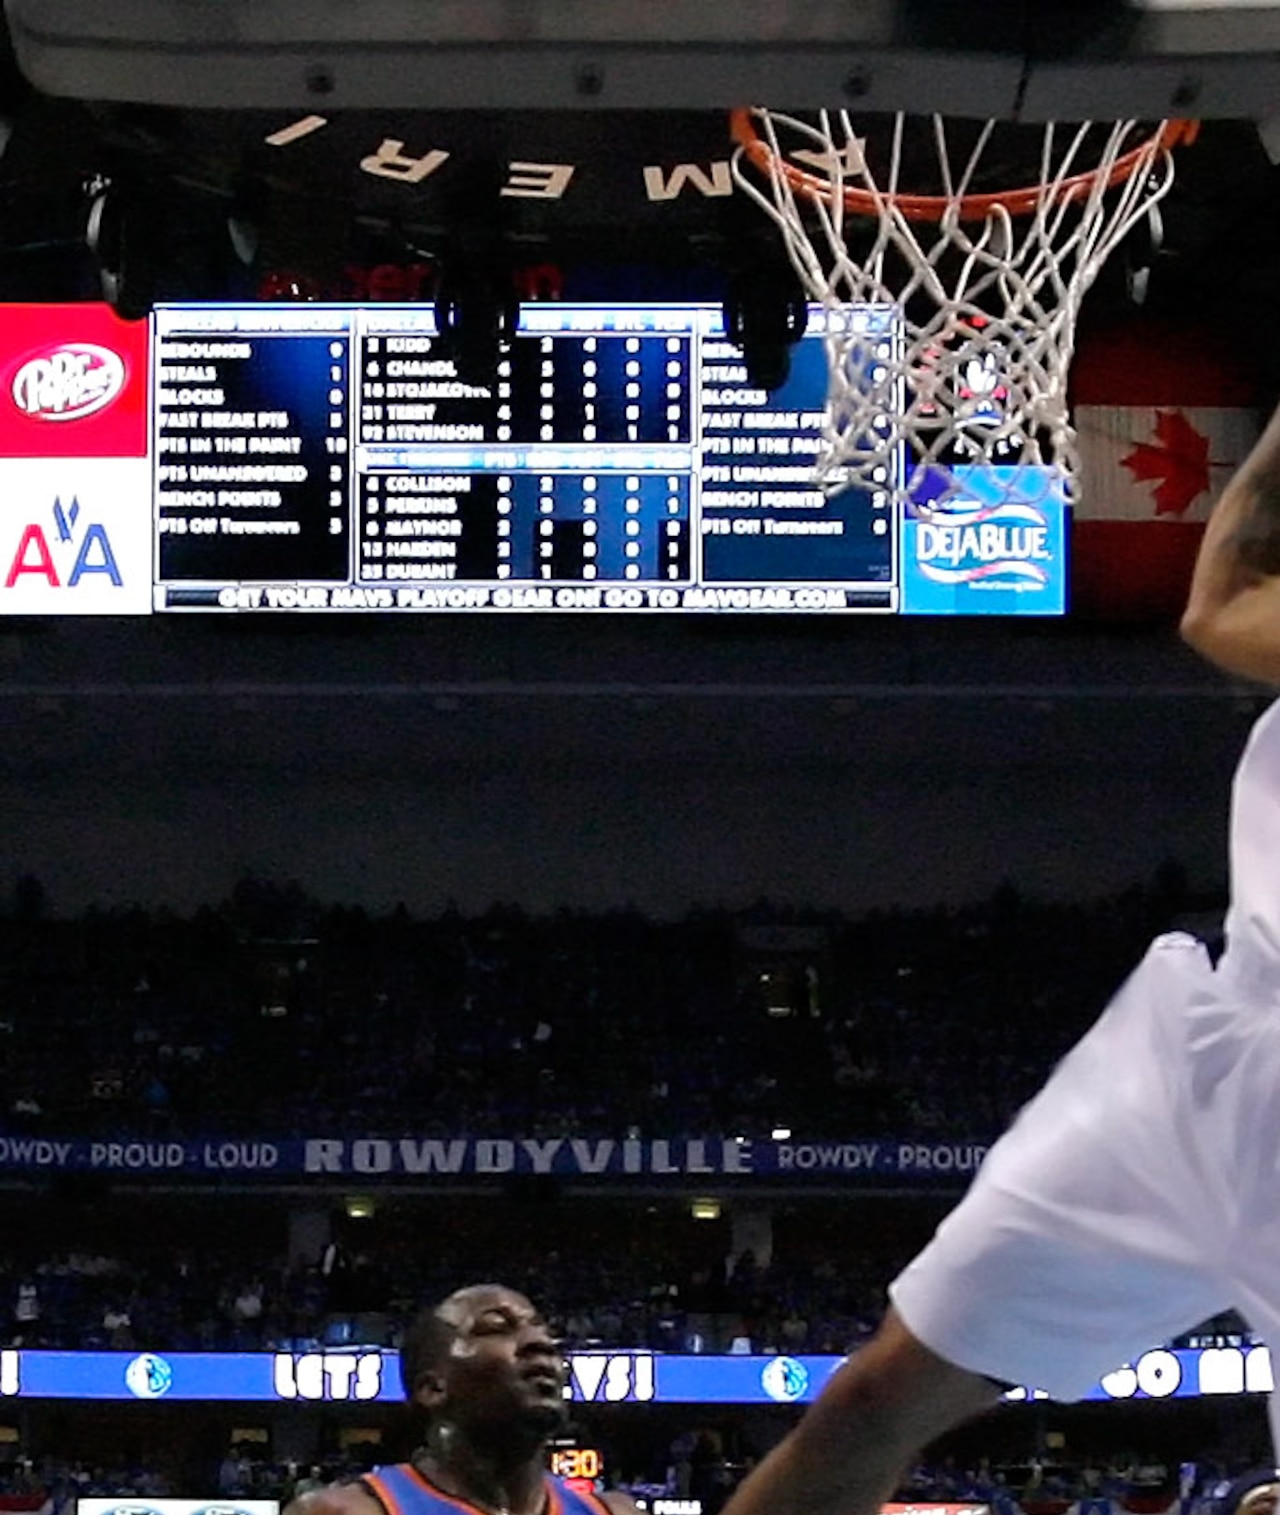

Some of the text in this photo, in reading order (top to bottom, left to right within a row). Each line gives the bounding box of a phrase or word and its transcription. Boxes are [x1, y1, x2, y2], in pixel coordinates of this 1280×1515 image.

[386, 337, 431, 353] KIDD
[386, 360, 457, 377] CHANDL
[385, 476, 471, 492] COLLISON
[263, 587, 329, 608] YOUR
[331, 587, 394, 608] MAVS
[398, 587, 494, 608] PLAYOFF
[604, 588, 644, 609] GO
[648, 588, 680, 609] TO
[91, 1142, 184, 1168] PROUD
[204, 1142, 279, 1169] LOUD
[304, 1138, 754, 1173] ROWDYVILLE
[778, 1145, 879, 1169] ROWDY
[273, 1354, 382, 1401] LETS
